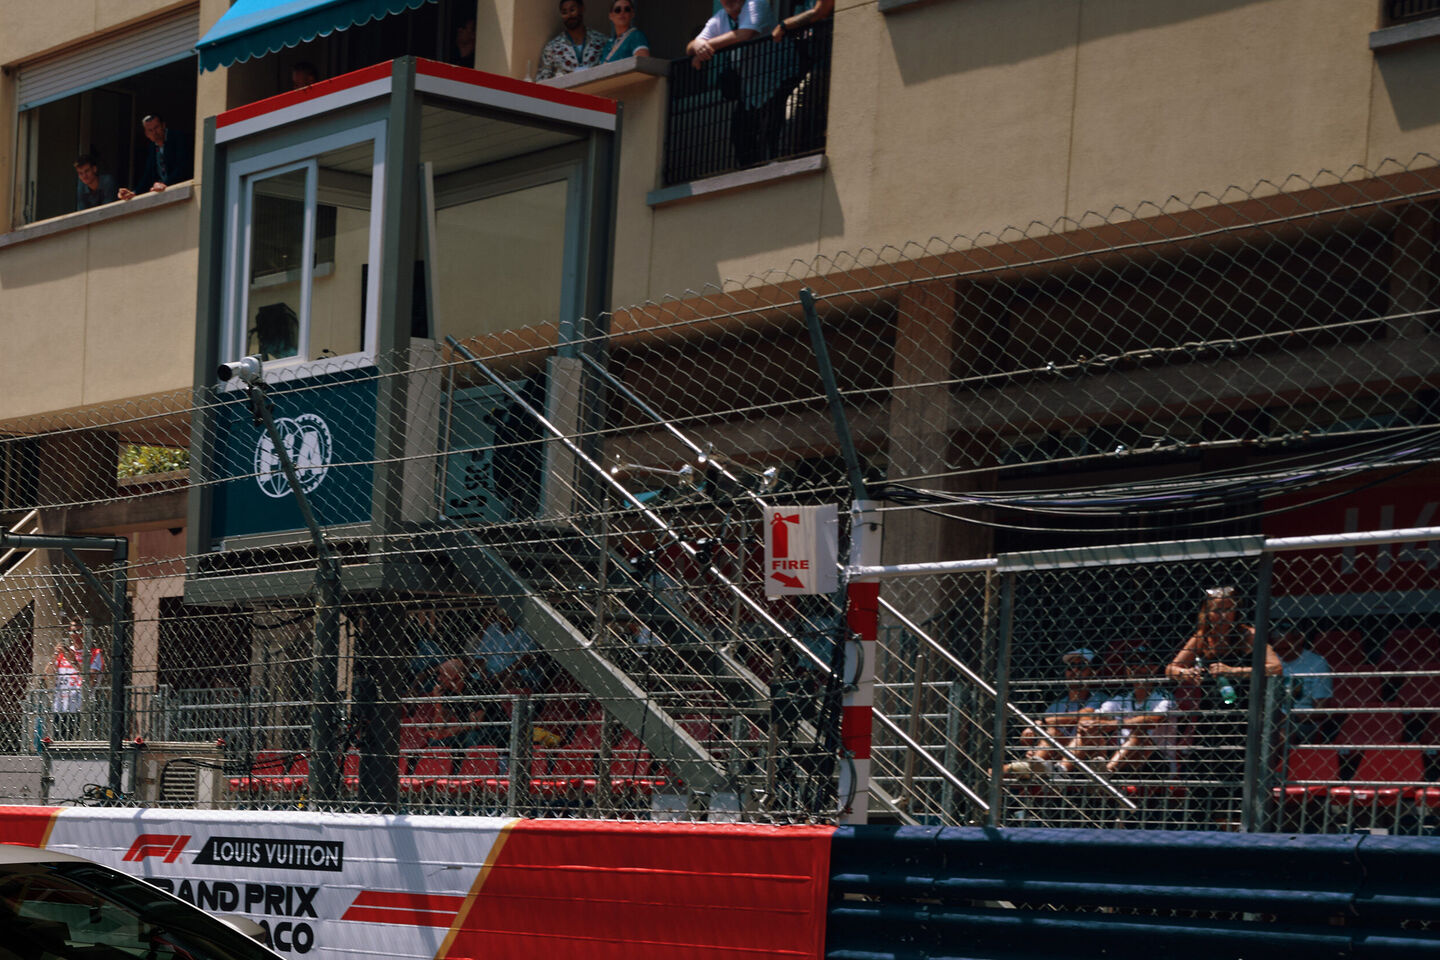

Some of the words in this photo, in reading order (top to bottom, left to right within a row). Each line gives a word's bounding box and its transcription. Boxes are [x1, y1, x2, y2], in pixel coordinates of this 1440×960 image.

[771, 559, 809, 570] FIRE
[121, 834, 192, 864] F1
[212, 841, 261, 863] LOUIS
[265, 843, 339, 867] VUITTON
[244, 883, 320, 919] PRIX
